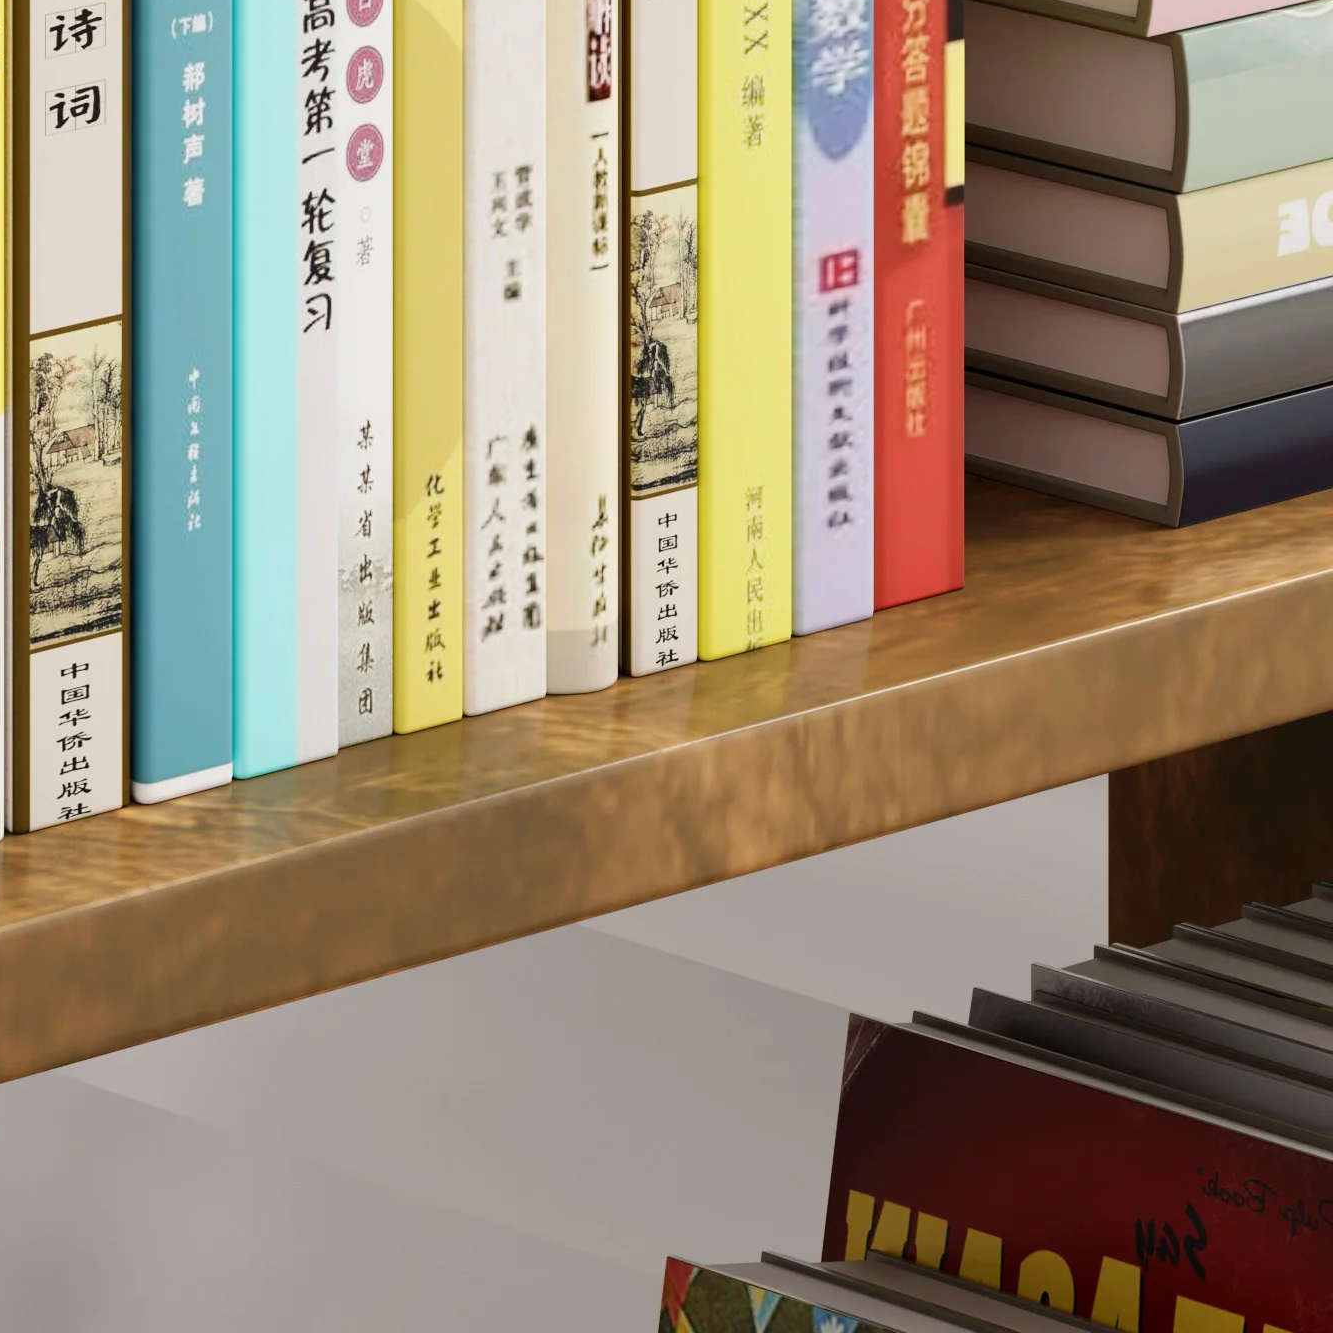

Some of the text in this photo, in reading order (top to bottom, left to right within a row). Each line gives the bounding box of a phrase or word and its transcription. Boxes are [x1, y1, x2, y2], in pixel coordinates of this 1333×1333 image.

[183, 61, 205, 165] 郝树声
[356, 419, 375, 715] 某某省出版集团
[426, 474, 445, 683] 化学工业出版社
[656, 513, 679, 666] 中国华侨出版社
[56, 662, 92, 820] 中国华侨出版社
